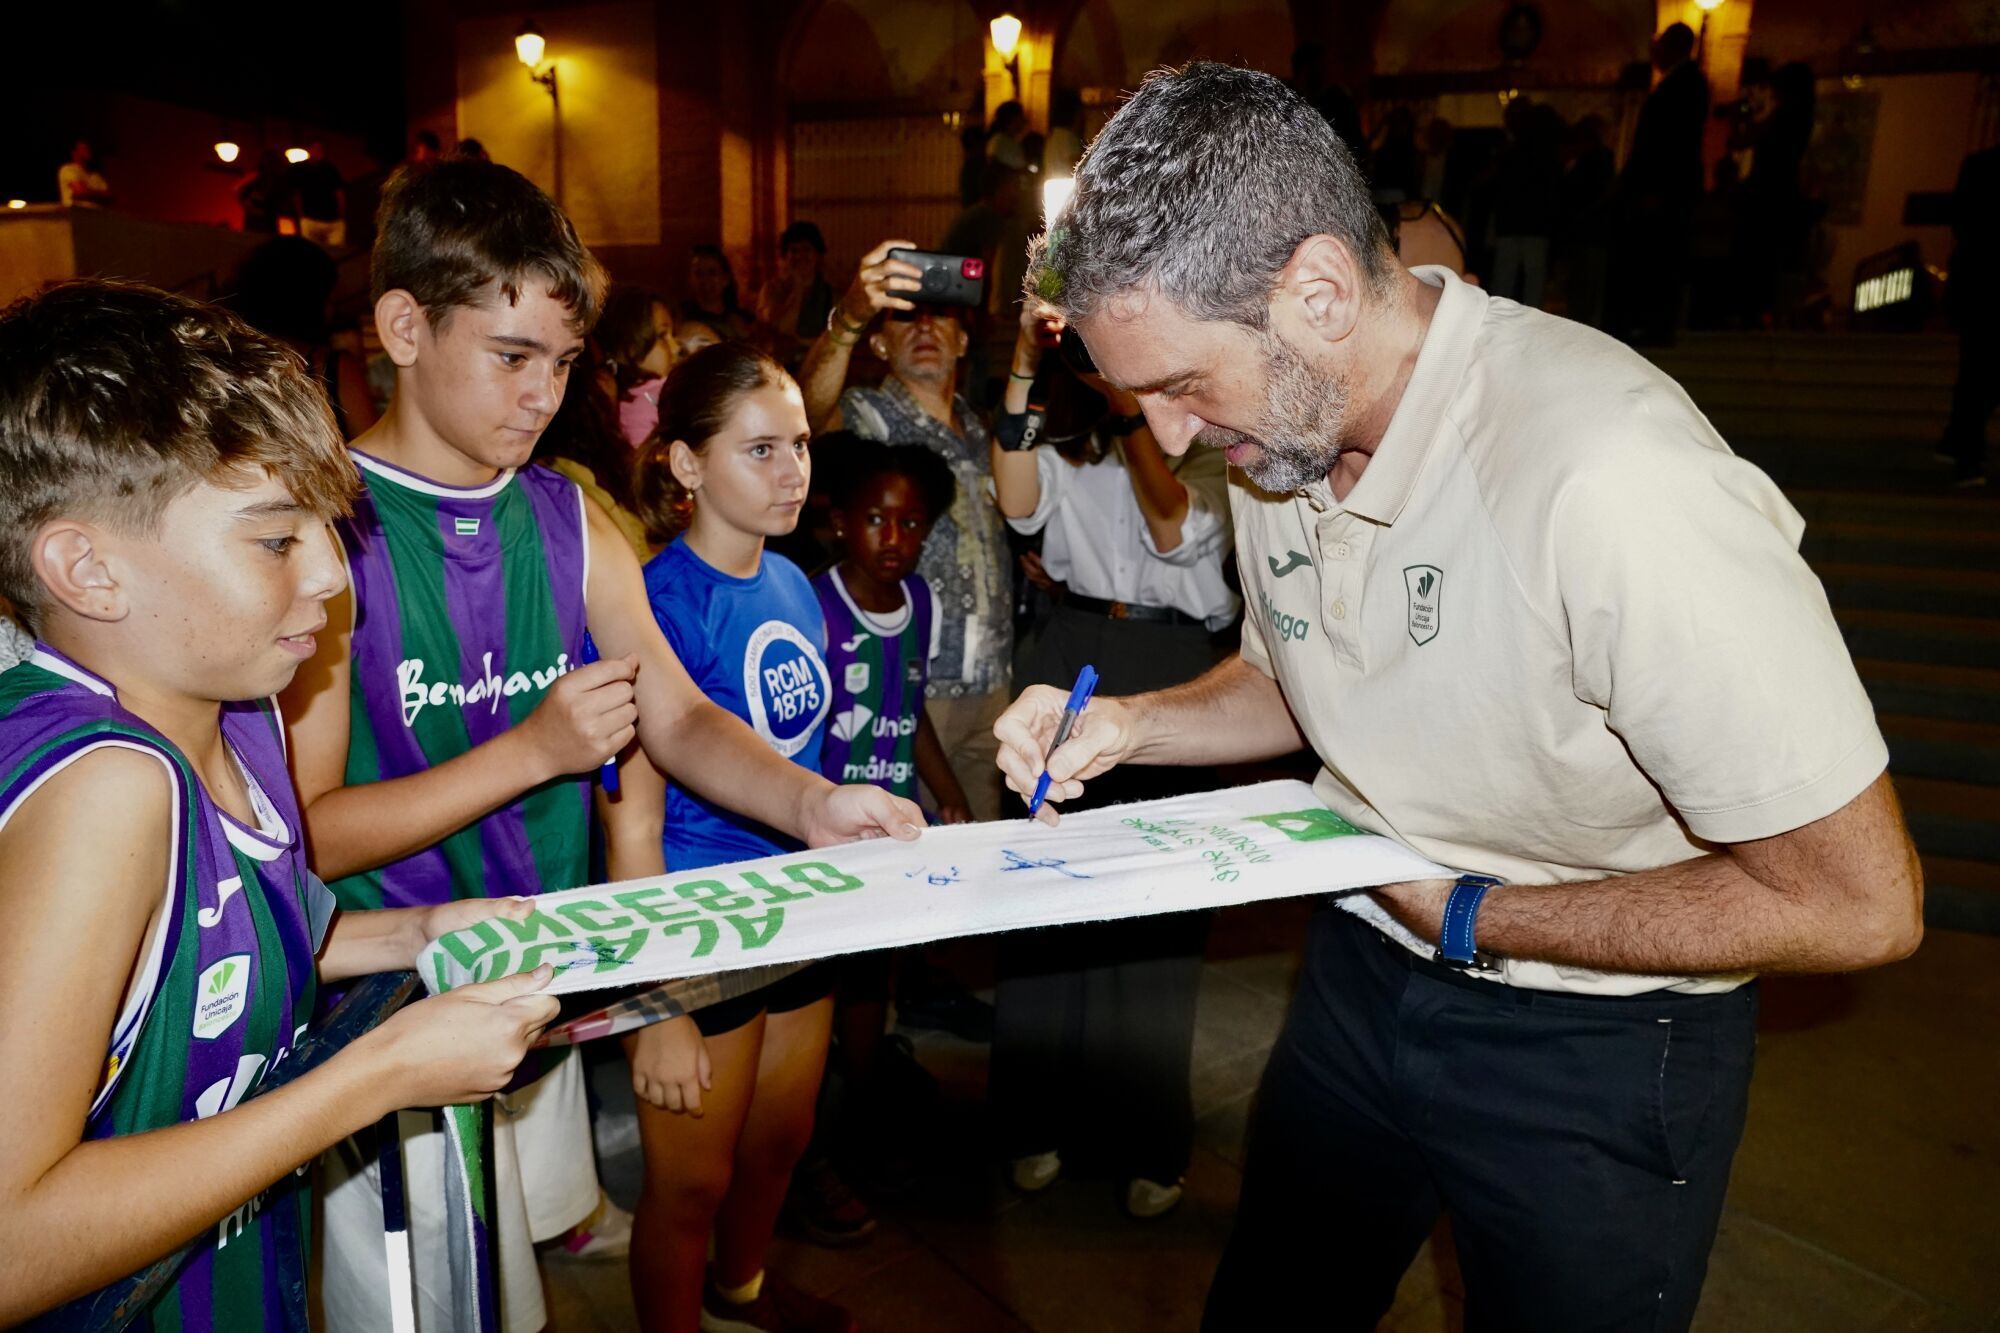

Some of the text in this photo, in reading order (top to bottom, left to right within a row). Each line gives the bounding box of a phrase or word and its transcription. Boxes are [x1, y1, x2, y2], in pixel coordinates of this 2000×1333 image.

[763, 655, 814, 698] RCM
[772, 681, 820, 723] 1873
[201, 991, 239, 1013] Fundación
[204, 1003, 233, 1021] Unicaja
